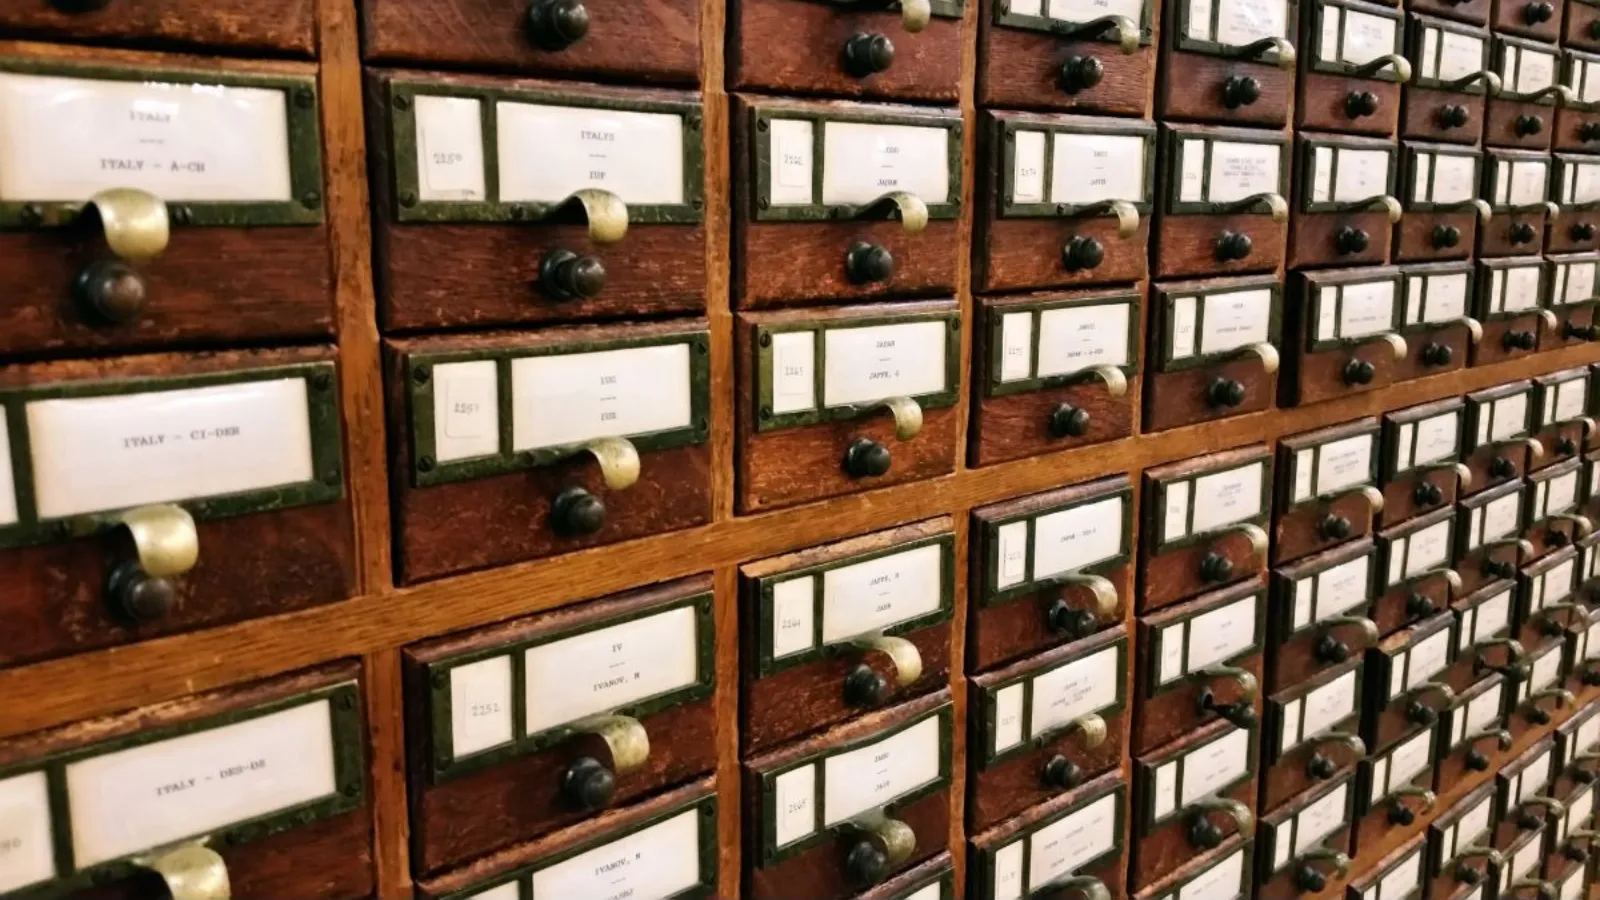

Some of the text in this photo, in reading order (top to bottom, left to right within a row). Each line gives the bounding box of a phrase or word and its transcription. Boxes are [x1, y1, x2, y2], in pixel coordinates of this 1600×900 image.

[100, 158, 144, 171] ITALY
[171, 160, 206, 173] A-CH
[123, 434, 165, 448] ITALY
[611, 643, 622, 653] IV
[593, 676, 629, 692] IVANOV,
[155, 778, 196, 797] ITALY
[594, 857, 630, 876] IVANOV,
